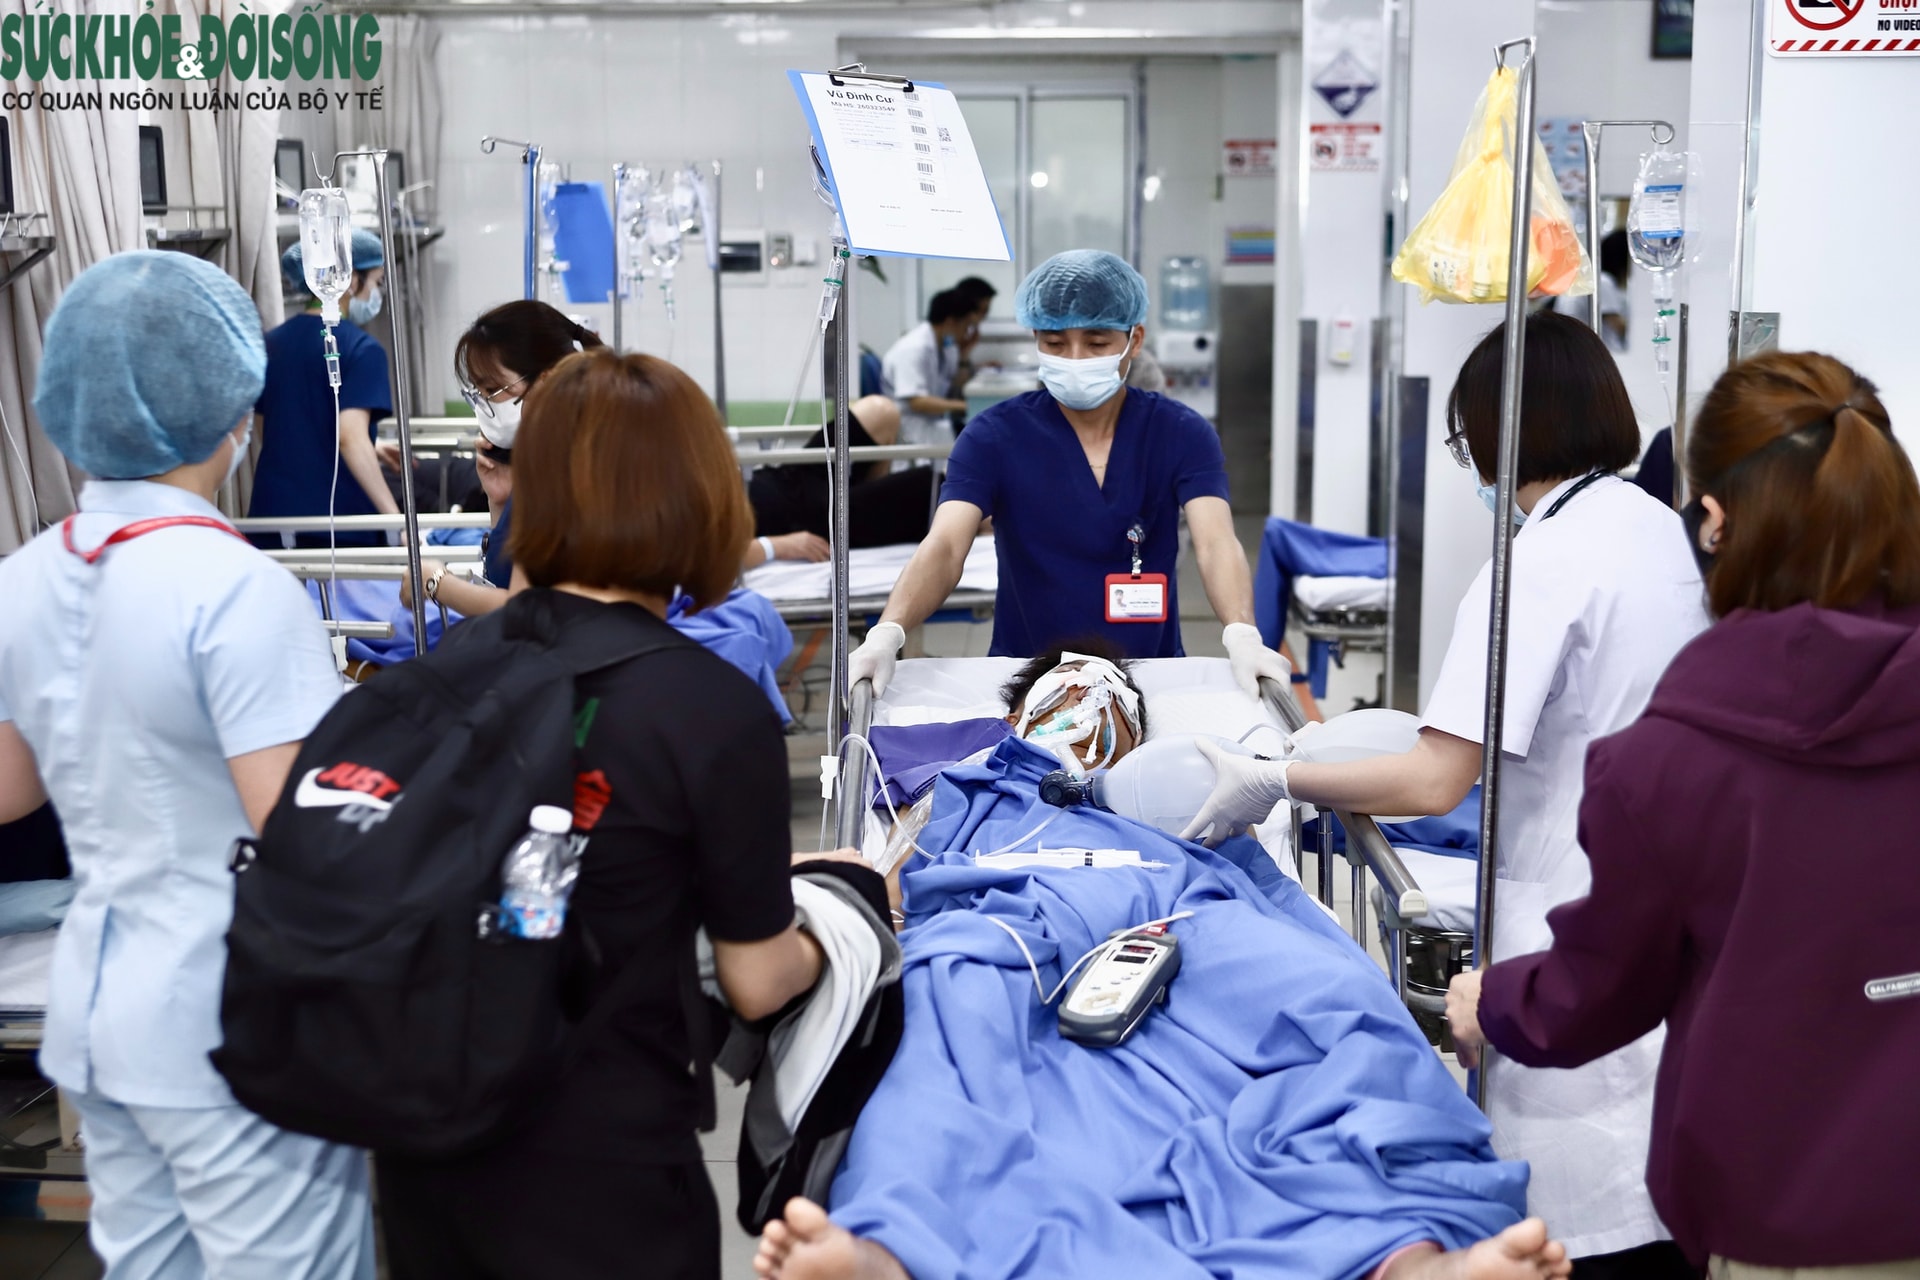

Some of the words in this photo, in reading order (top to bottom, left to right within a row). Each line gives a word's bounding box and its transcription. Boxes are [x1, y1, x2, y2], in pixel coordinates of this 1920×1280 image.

[1878, 20, 1891, 31] NO
[827, 89, 844, 99] Vũ
[846, 91, 874, 102] Đình
[316, 761, 401, 799] JUST
